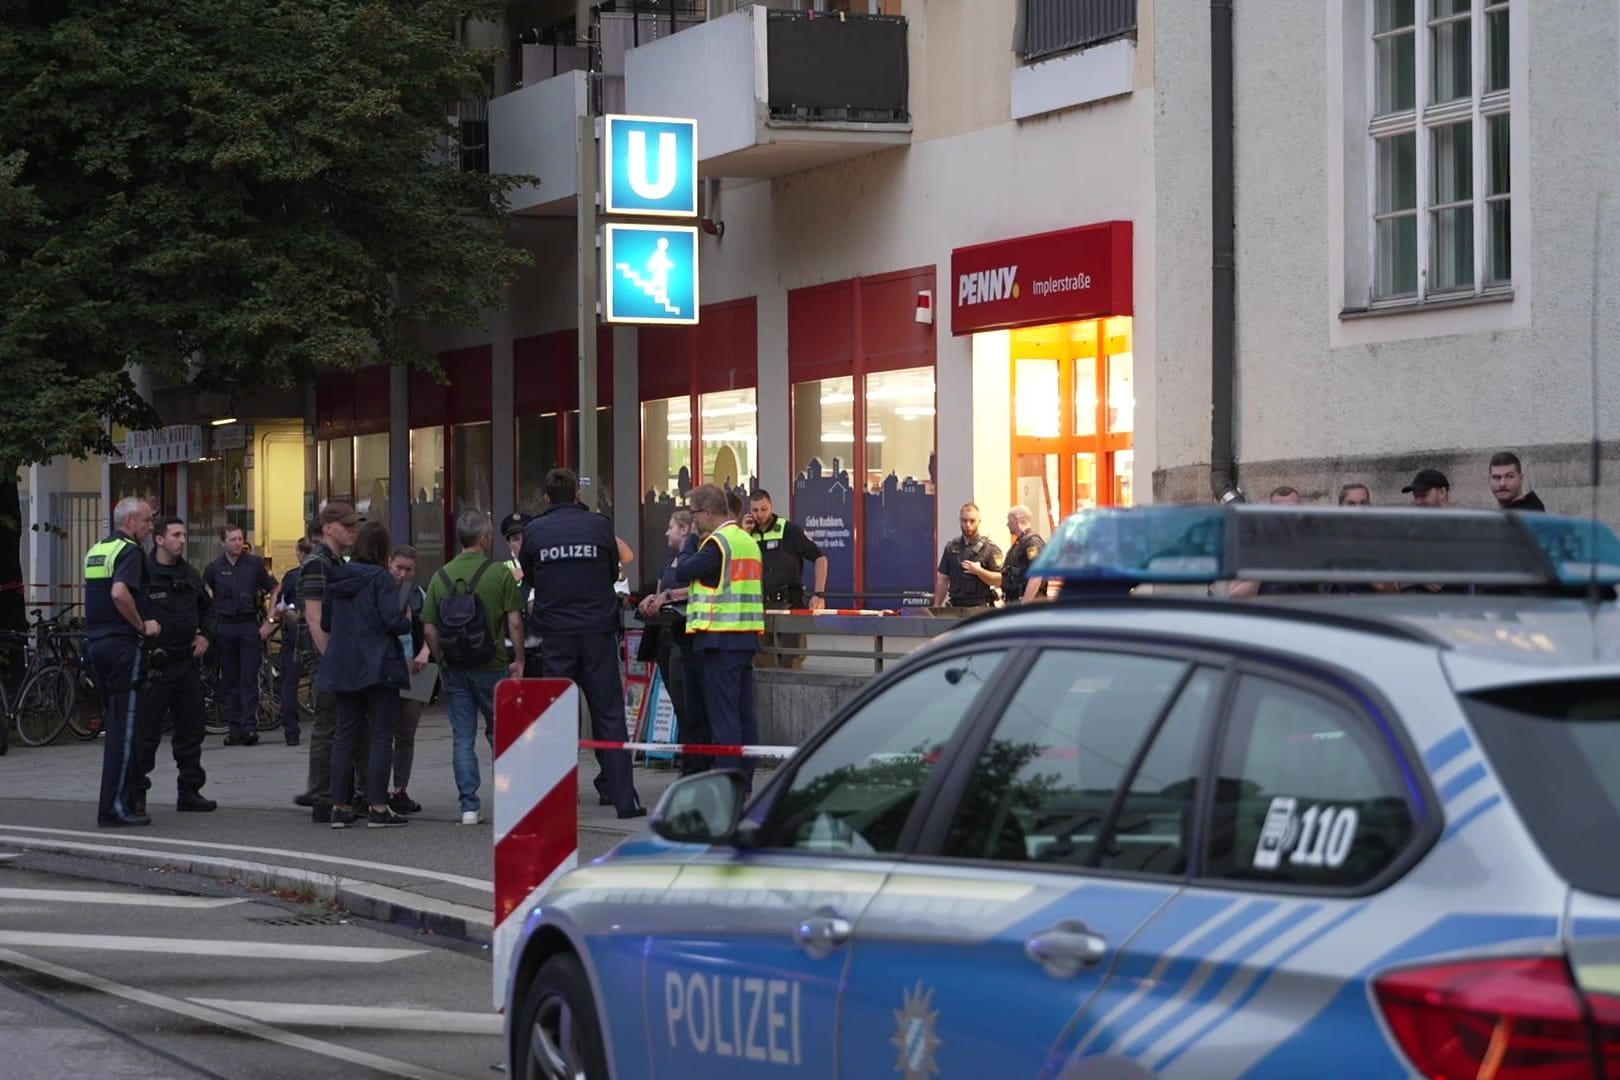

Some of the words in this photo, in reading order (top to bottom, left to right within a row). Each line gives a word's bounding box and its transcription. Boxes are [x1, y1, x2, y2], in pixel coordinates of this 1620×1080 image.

[627, 130, 677, 200] U
[1032, 272, 1092, 297] Implerstraße
[540, 544, 598, 561] POLIZEI
[1289, 804, 1359, 868] 110
[665, 971, 801, 1065] POLIZEI
